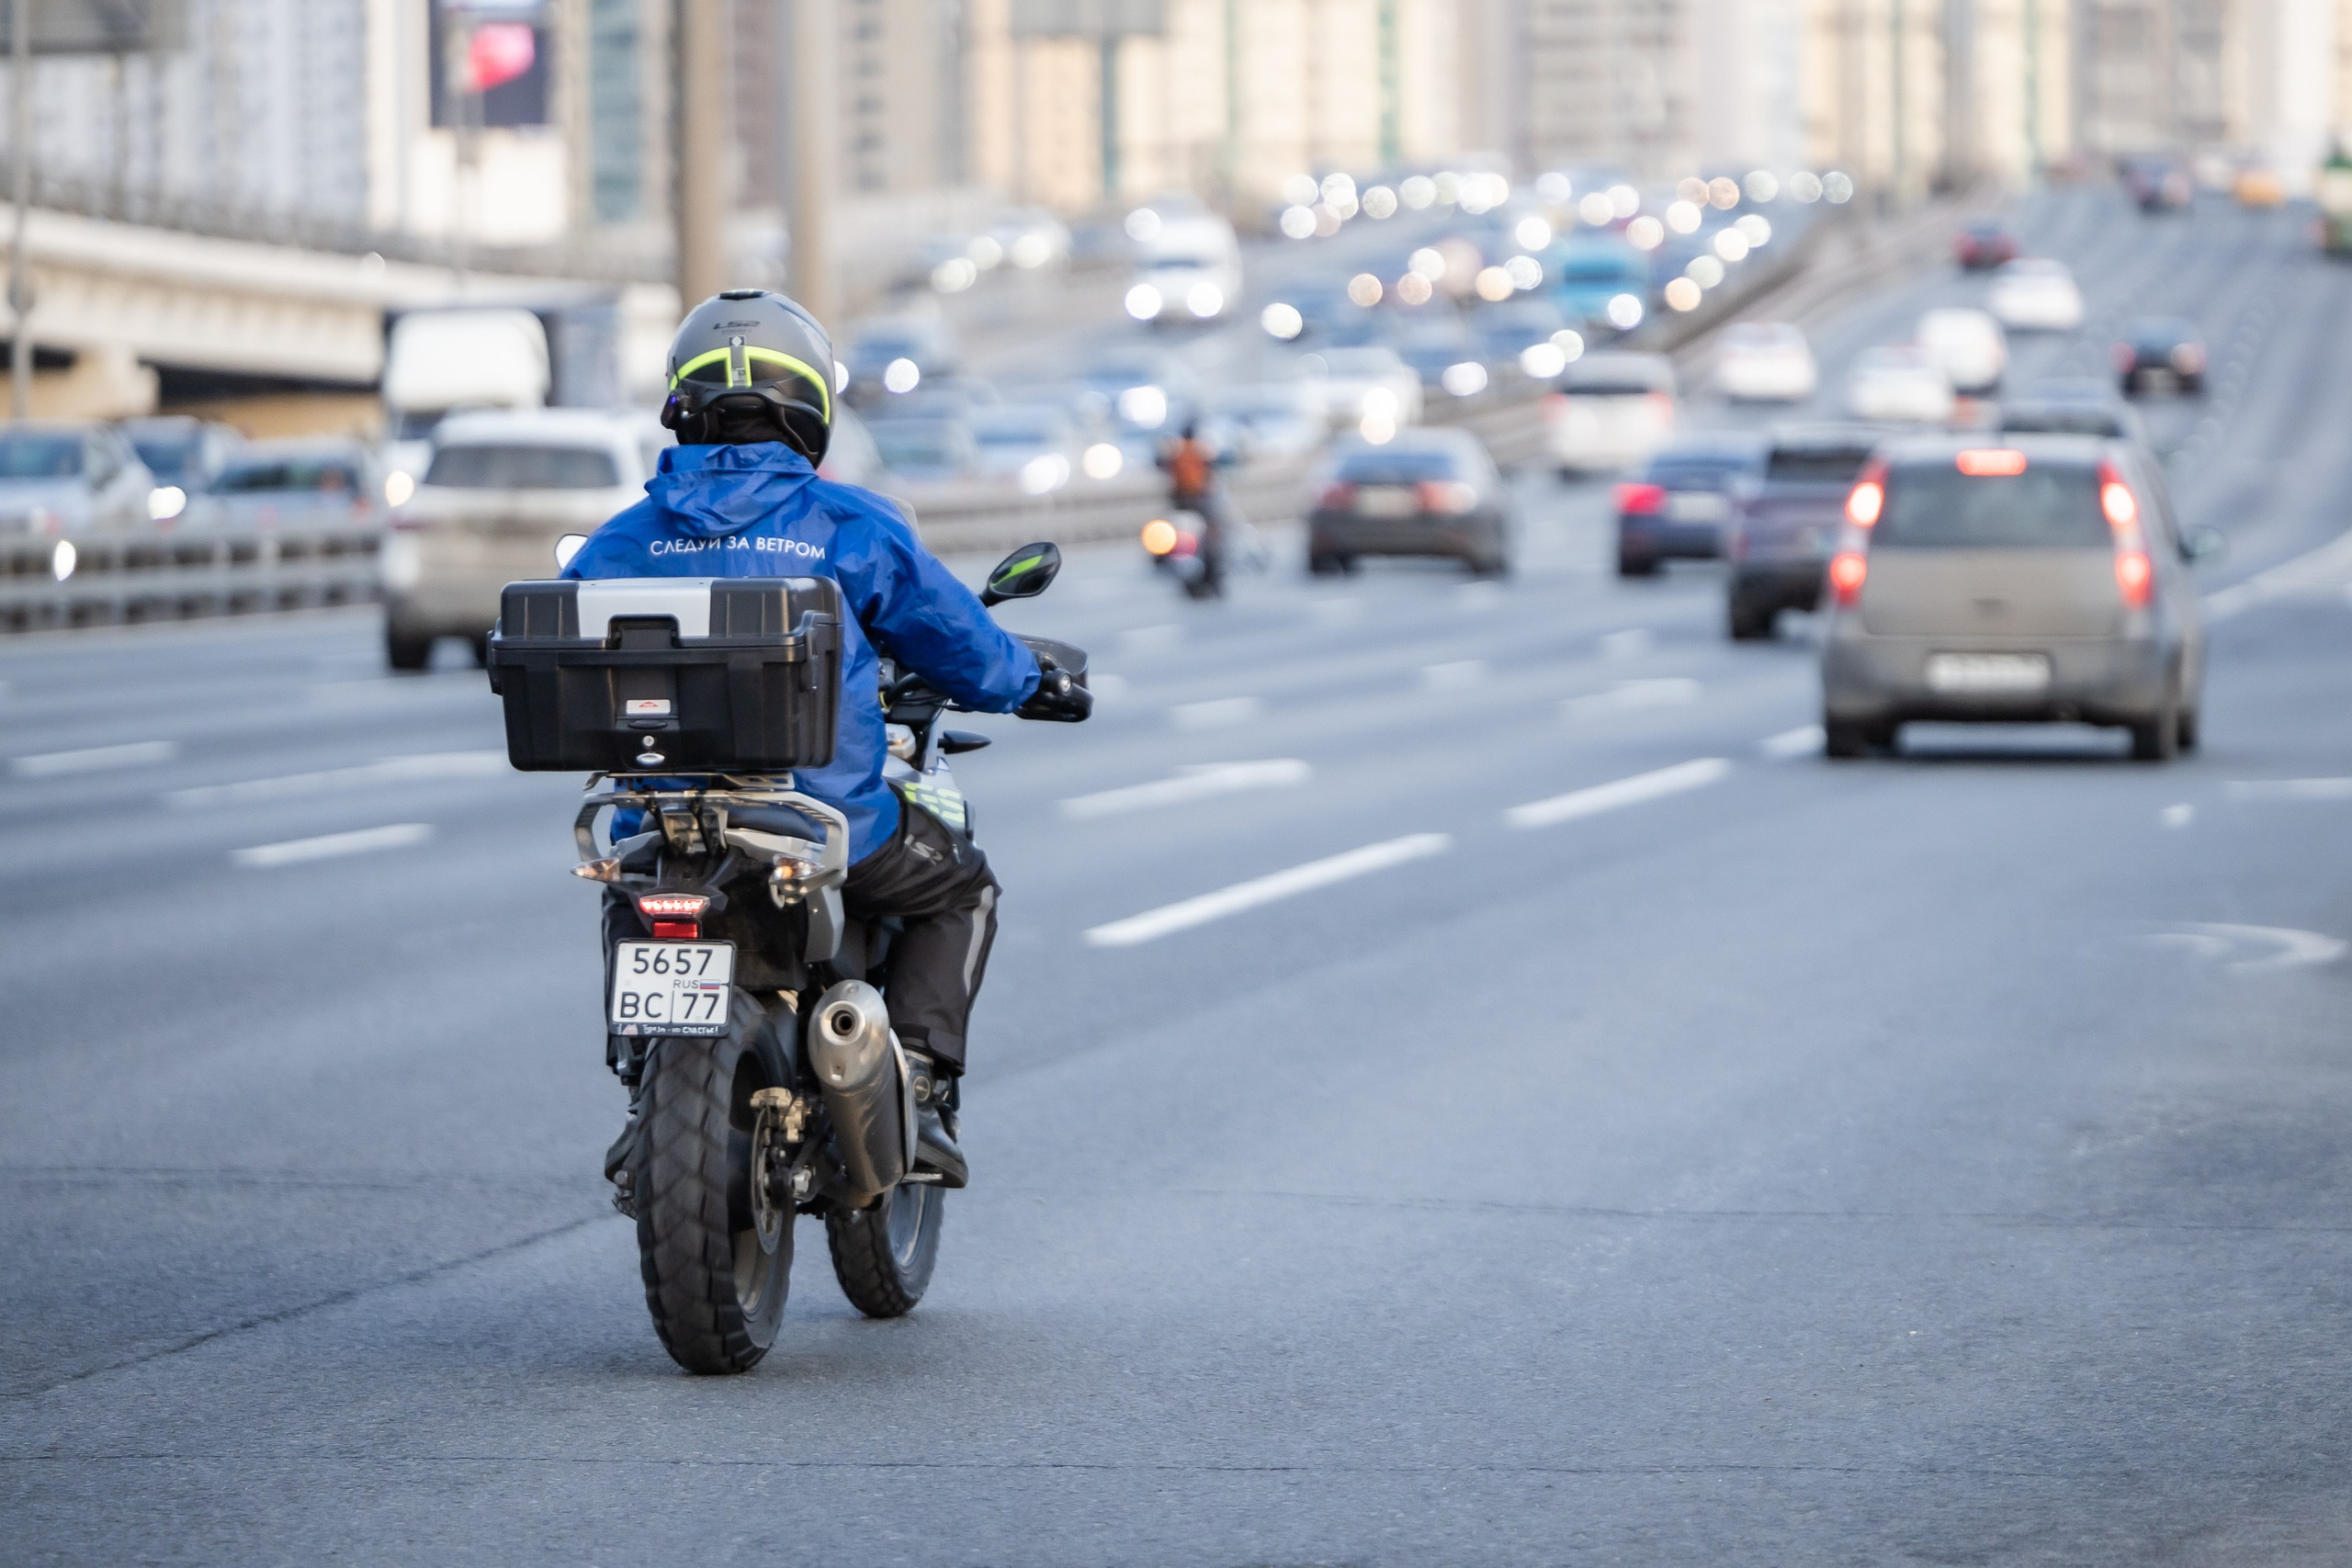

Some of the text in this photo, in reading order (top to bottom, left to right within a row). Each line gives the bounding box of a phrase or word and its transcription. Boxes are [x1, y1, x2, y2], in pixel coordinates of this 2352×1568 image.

[713, 320, 760, 330] LS2
[726, 536, 750, 549] ЗА
[755, 536, 826, 559] ВЕТРОМ
[633, 948, 713, 976] 5657
[673, 979, 699, 989] RUS
[683, 993, 719, 1020] 77
